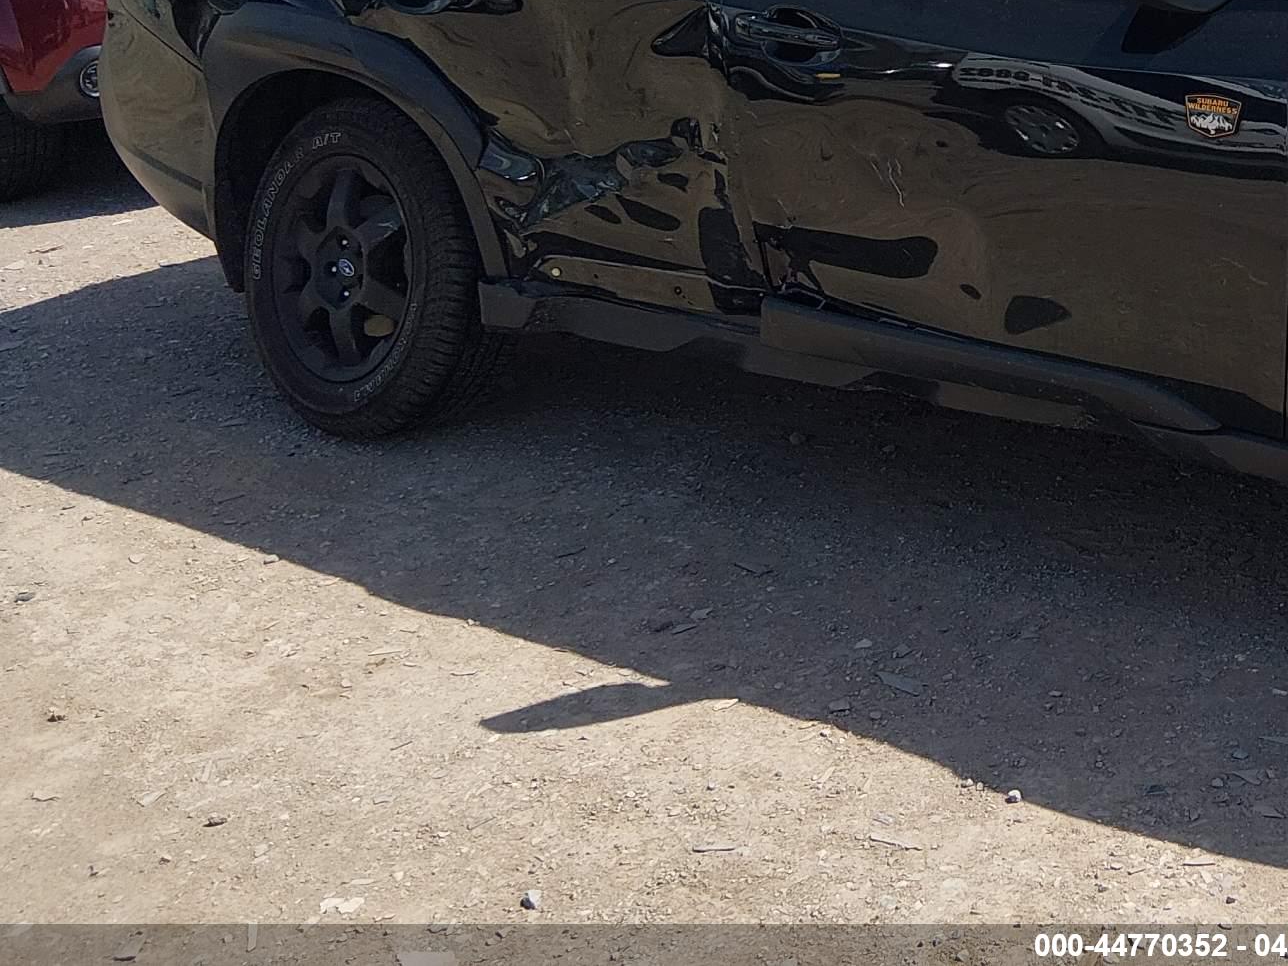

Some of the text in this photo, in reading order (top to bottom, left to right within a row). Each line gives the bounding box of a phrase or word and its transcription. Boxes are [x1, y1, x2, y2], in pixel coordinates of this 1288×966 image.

[1188, 102, 1238, 115] WILDERNESS
[1196, 97, 1229, 107] SUBARU
[253, 132, 342, 280] GEOLANDAR A/T
